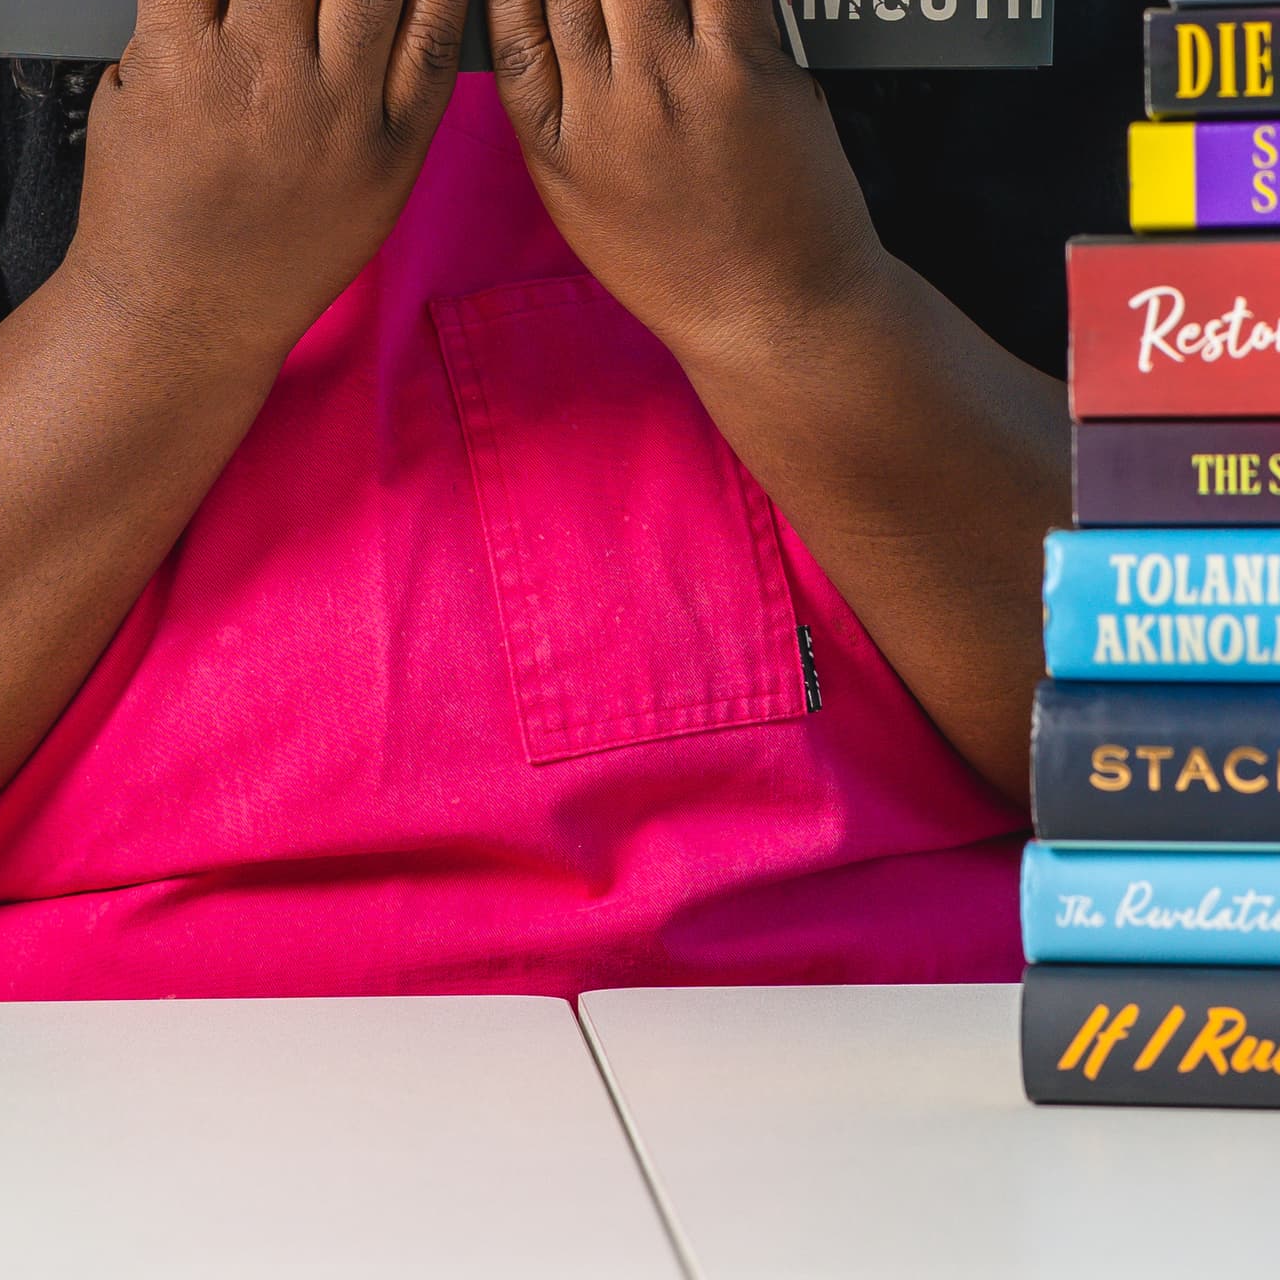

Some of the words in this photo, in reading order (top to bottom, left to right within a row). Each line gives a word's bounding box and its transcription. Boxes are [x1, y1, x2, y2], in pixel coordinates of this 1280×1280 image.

[1175, 21, 1274, 99] DIE
[1191, 453, 1261, 495] THE
[1056, 892, 1105, 929] The
[1057, 1003, 1140, 1081] If
[1133, 1005, 1187, 1072] I
